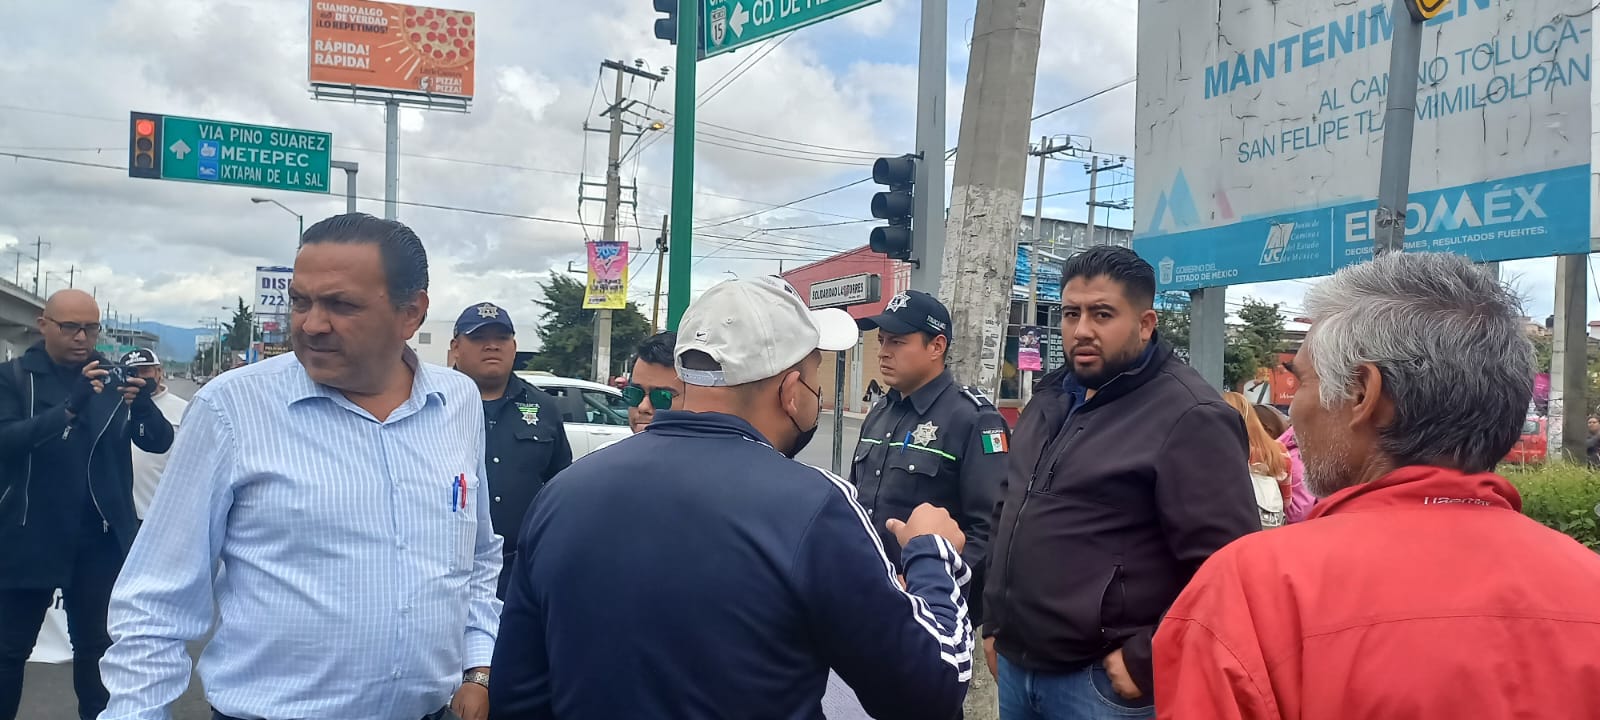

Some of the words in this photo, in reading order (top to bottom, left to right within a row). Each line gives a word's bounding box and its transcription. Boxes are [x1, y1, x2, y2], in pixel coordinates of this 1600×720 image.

[316, 2, 357, 14] CUANDO
[358, 7, 383, 17] ALGO
[752, 0, 775, 26] CD.
[332, 20, 389, 33] REPETIMOS!
[335, 12, 348, 22] DE
[349, 14, 388, 26] VERDAD
[714, 22, 723, 41] 15
[315, 38, 370, 56] RÁPIDA!
[315, 53, 370, 69] RÁPIDA!
[1318, 87, 1345, 114] AL
[1454, 19, 1591, 75] TOLUCA-
[435, 76, 462, 85] PIZZA!
[435, 84, 462, 93] PIZZA!
[199, 124, 224, 140] VIA
[230, 127, 263, 145] PINO
[270, 132, 325, 151] SUAREZ
[1238, 135, 1275, 164] SAN
[1281, 115, 1349, 153] FELIPE
[221, 146, 309, 167] METEPEC
[220, 165, 261, 181] IXTAPAN
[267, 169, 280, 183] DE
[287, 171, 299, 185] LA
[305, 173, 323, 187] SAL
[1345, 183, 1549, 243] EOMÉX
[1432, 233, 1495, 247] RESULTADOS
[1175, 265, 1204, 274] GOBIERNO
[1204, 263, 1216, 271] DEL
[1175, 273, 1200, 283] ESTADO
[1201, 272, 1211, 280] DE
[1211, 268, 1239, 279] MÉXICO
[261, 294, 285, 306] 722
[812, 286, 838, 300] SOLIDARIDAD
